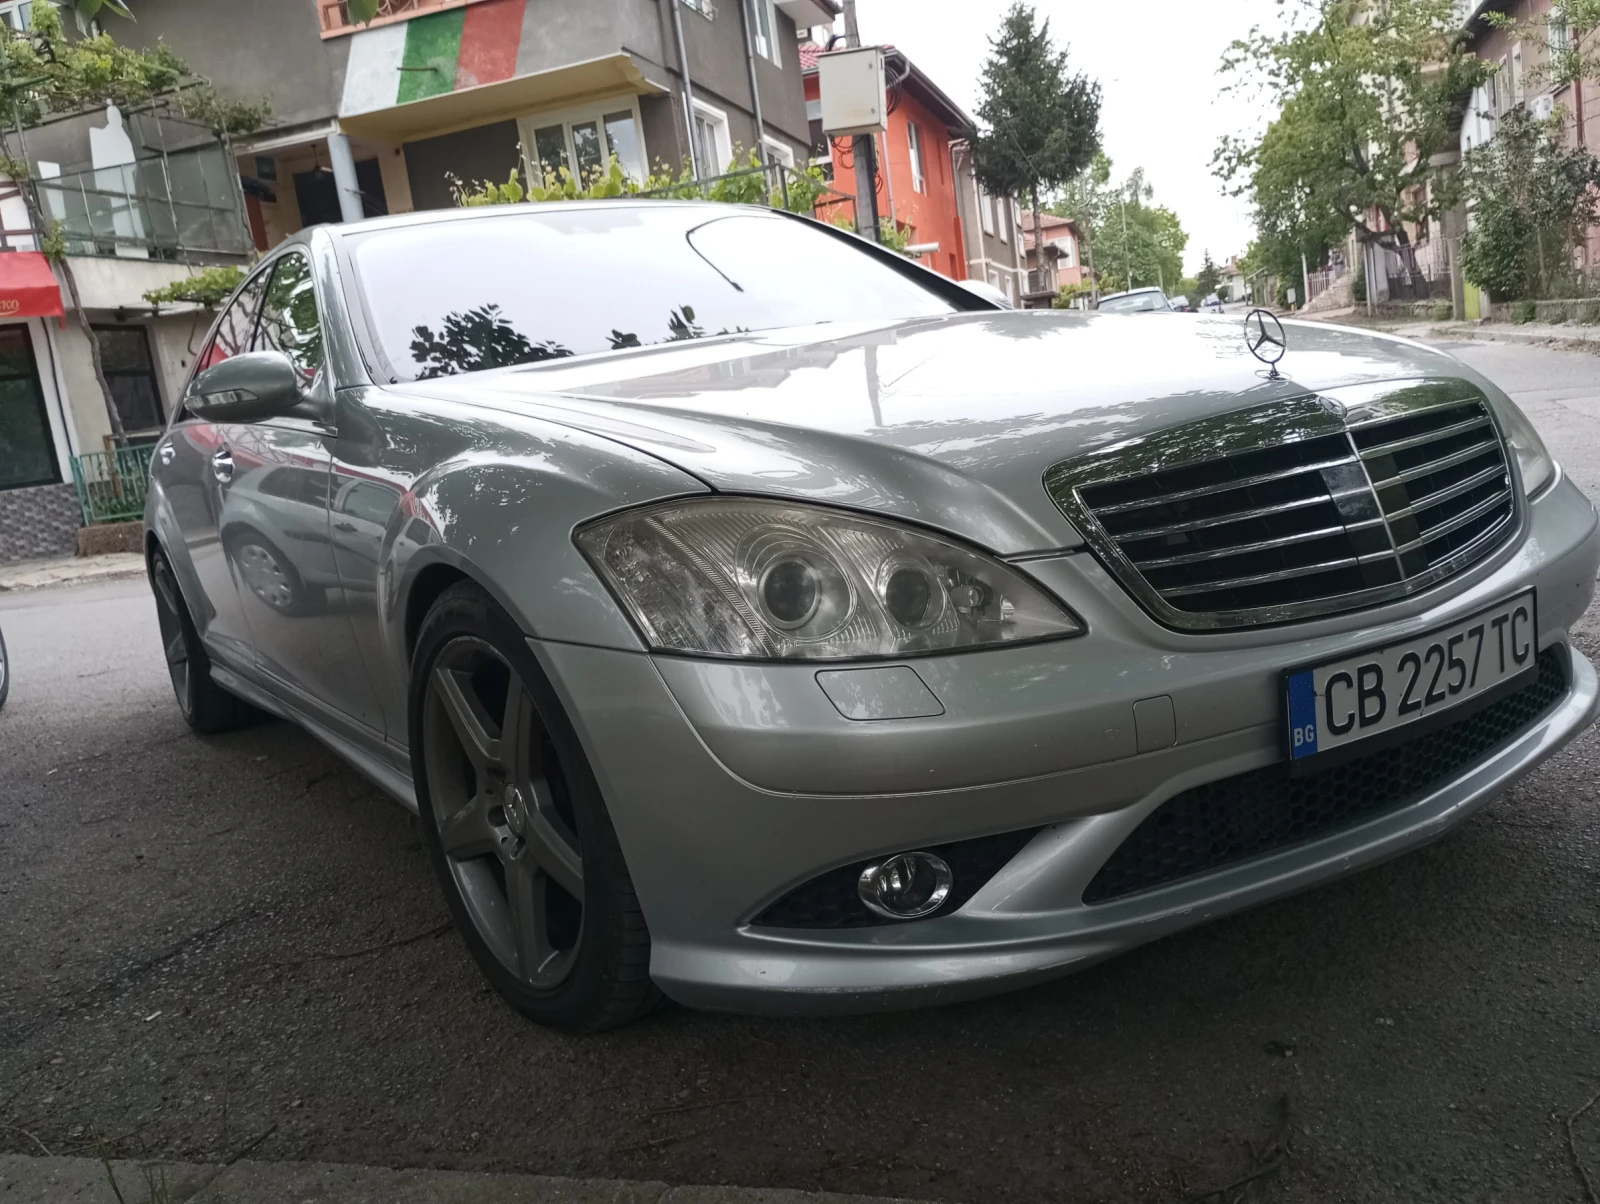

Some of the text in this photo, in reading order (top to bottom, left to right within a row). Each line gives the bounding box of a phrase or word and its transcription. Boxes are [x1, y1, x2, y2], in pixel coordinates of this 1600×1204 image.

[1325, 606, 1530, 736] CB 2257 TC
[1293, 724, 1315, 747] BG
